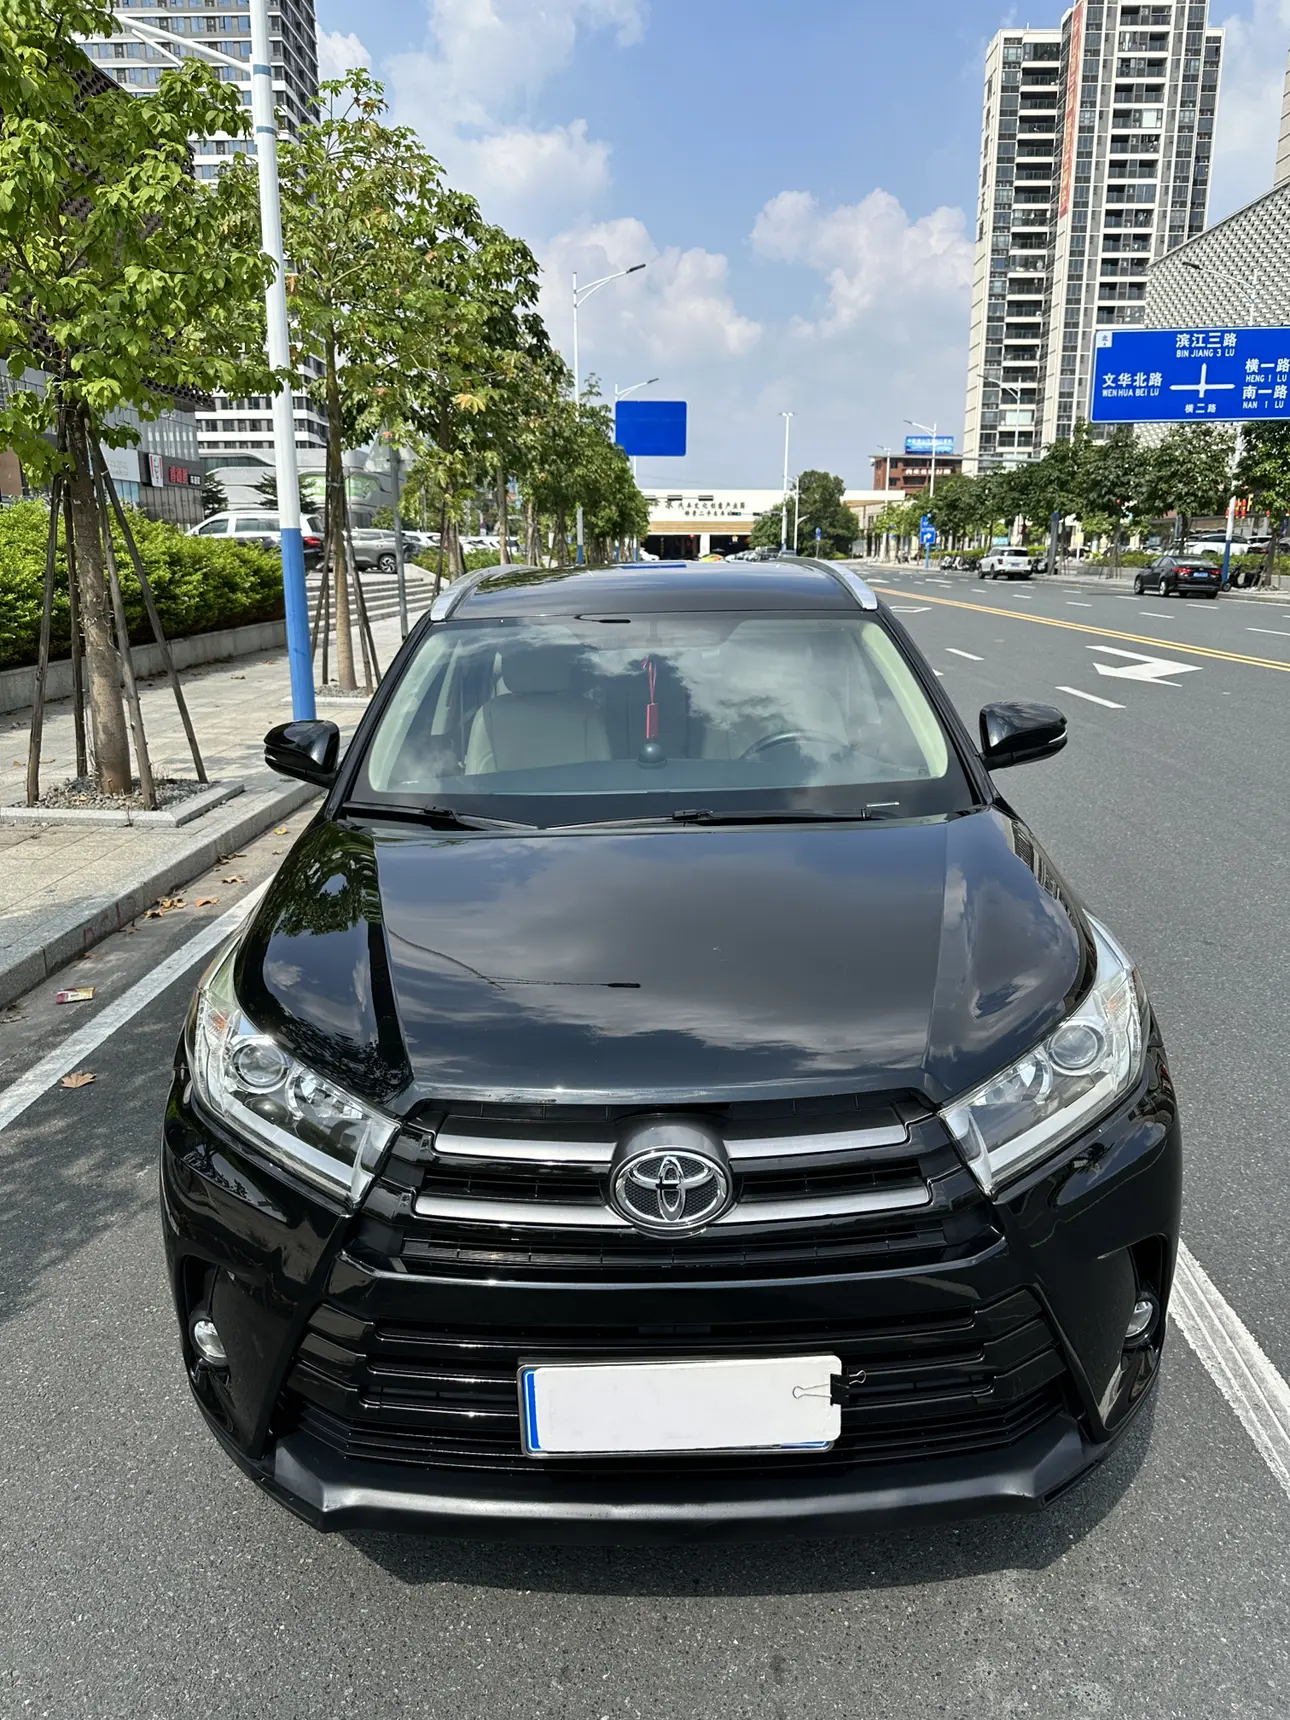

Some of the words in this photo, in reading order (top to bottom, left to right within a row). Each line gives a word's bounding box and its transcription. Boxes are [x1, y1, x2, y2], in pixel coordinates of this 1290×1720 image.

[1175, 332, 1237, 348] 滨江三路
[1176, 349, 1190, 358] BIN
[1190, 349, 1214, 357] JIANG
[1216, 348, 1222, 357] 3
[1225, 348, 1235, 357] LU
[1245, 357, 1290, 373] 横一路
[1102, 371, 1163, 388] 文华北路
[1245, 374, 1265, 383] HENG
[1276, 373, 1288, 383] LU
[1135, 388, 1148, 397] BEI
[1150, 387, 1160, 397] LU
[1242, 384, 1288, 400] 南一路
[1242, 400, 1258, 409] NAN
[1274, 400, 1285, 409] LU
